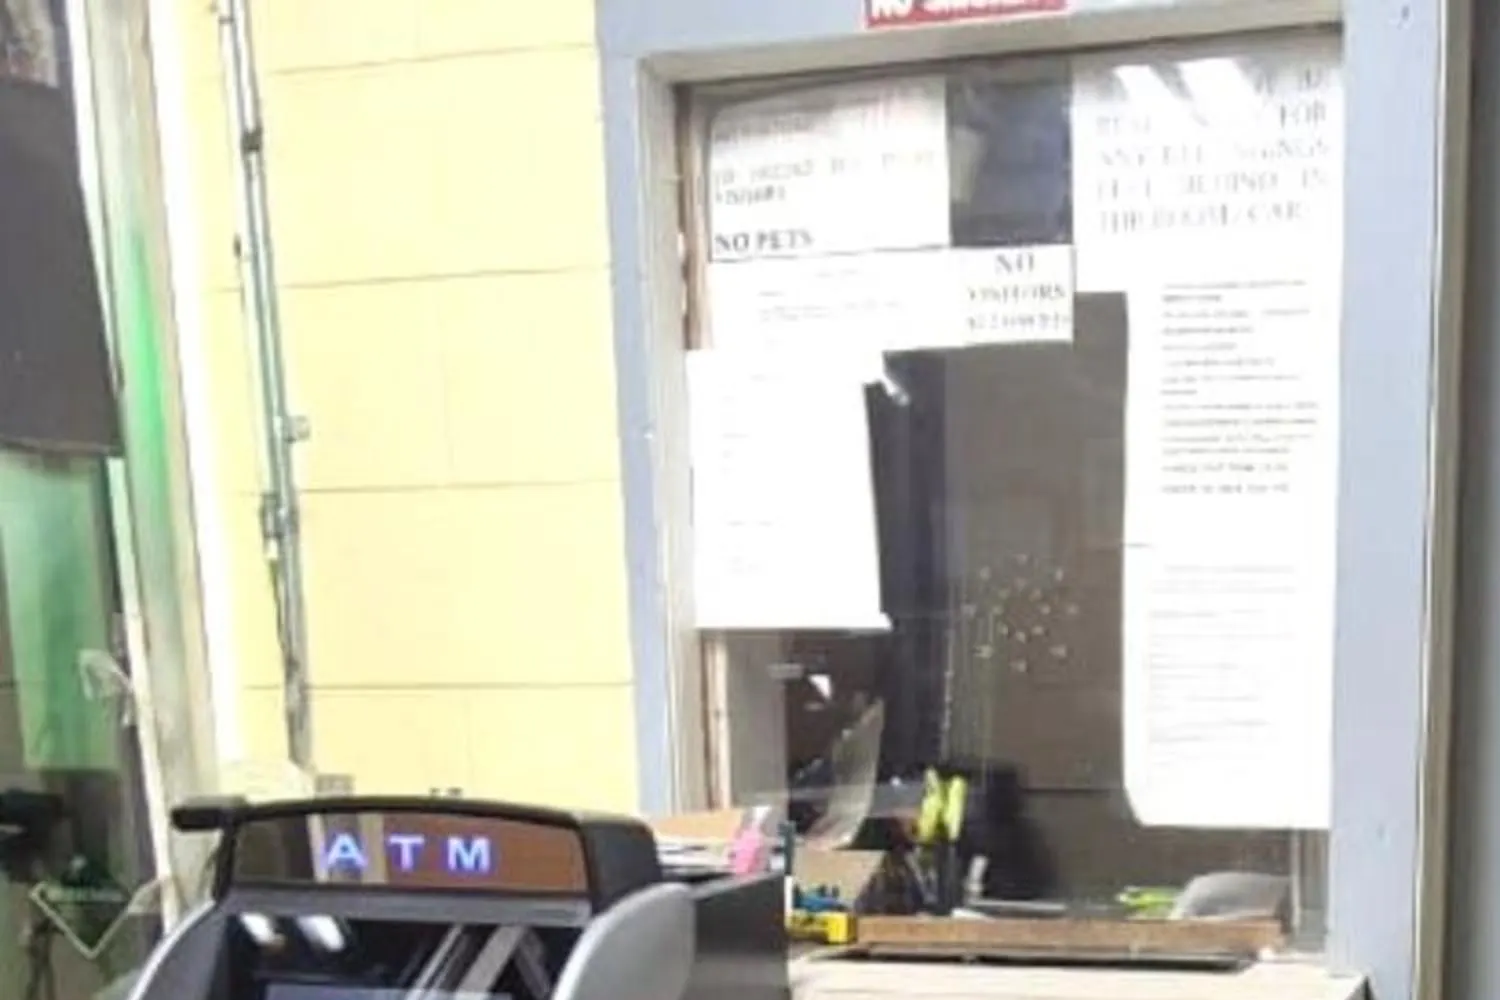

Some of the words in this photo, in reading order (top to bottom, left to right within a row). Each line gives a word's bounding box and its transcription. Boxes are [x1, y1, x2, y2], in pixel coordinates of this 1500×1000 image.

[714, 232, 750, 252] NO
[756, 228, 815, 251] PETS
[994, 251, 1036, 275] NO
[324, 832, 491, 872] ATM
